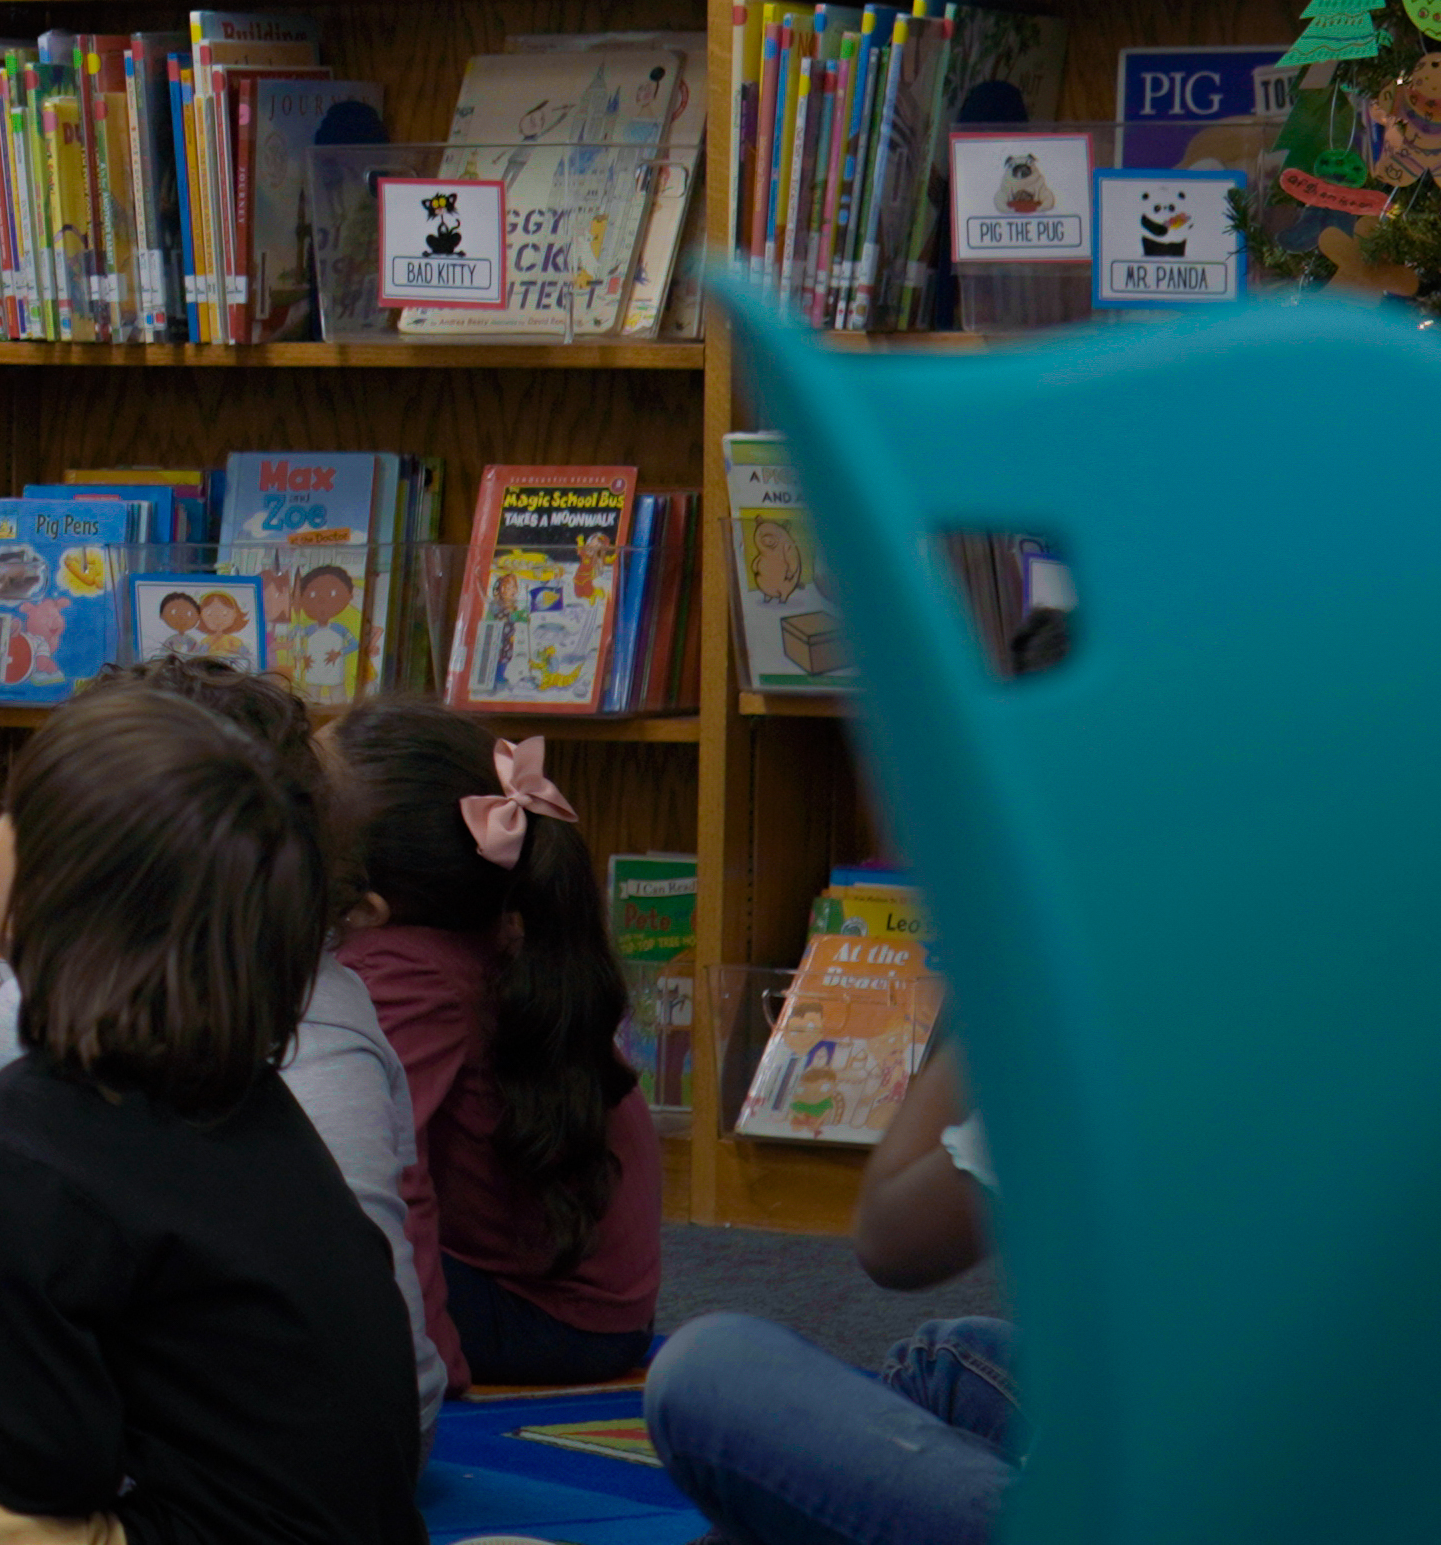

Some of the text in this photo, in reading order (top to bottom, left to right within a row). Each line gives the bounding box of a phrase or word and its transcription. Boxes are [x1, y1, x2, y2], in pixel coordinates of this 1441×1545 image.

[1139, 70, 1224, 116] PIG
[237, 166, 247, 225] JOURNEY
[979, 219, 1065, 241] PIG THE PUG
[406, 262, 477, 285] BAD KITTY
[1125, 266, 1208, 290] MR. PANDA
[258, 460, 335, 493] Max
[289, 492, 311, 503] and
[503, 489, 625, 511] Magic School Bus
[762, 491, 792, 504] AND
[261, 494, 328, 532] Zoe
[504, 510, 617, 529] TAKES A MOONWALK
[36, 515, 99, 539] Pig Pens
[314, 530, 349, 543] Doctor
[624, 902, 672, 932] Pete
[885, 912, 921, 934] Leo
[833, 941, 910, 967] At the
